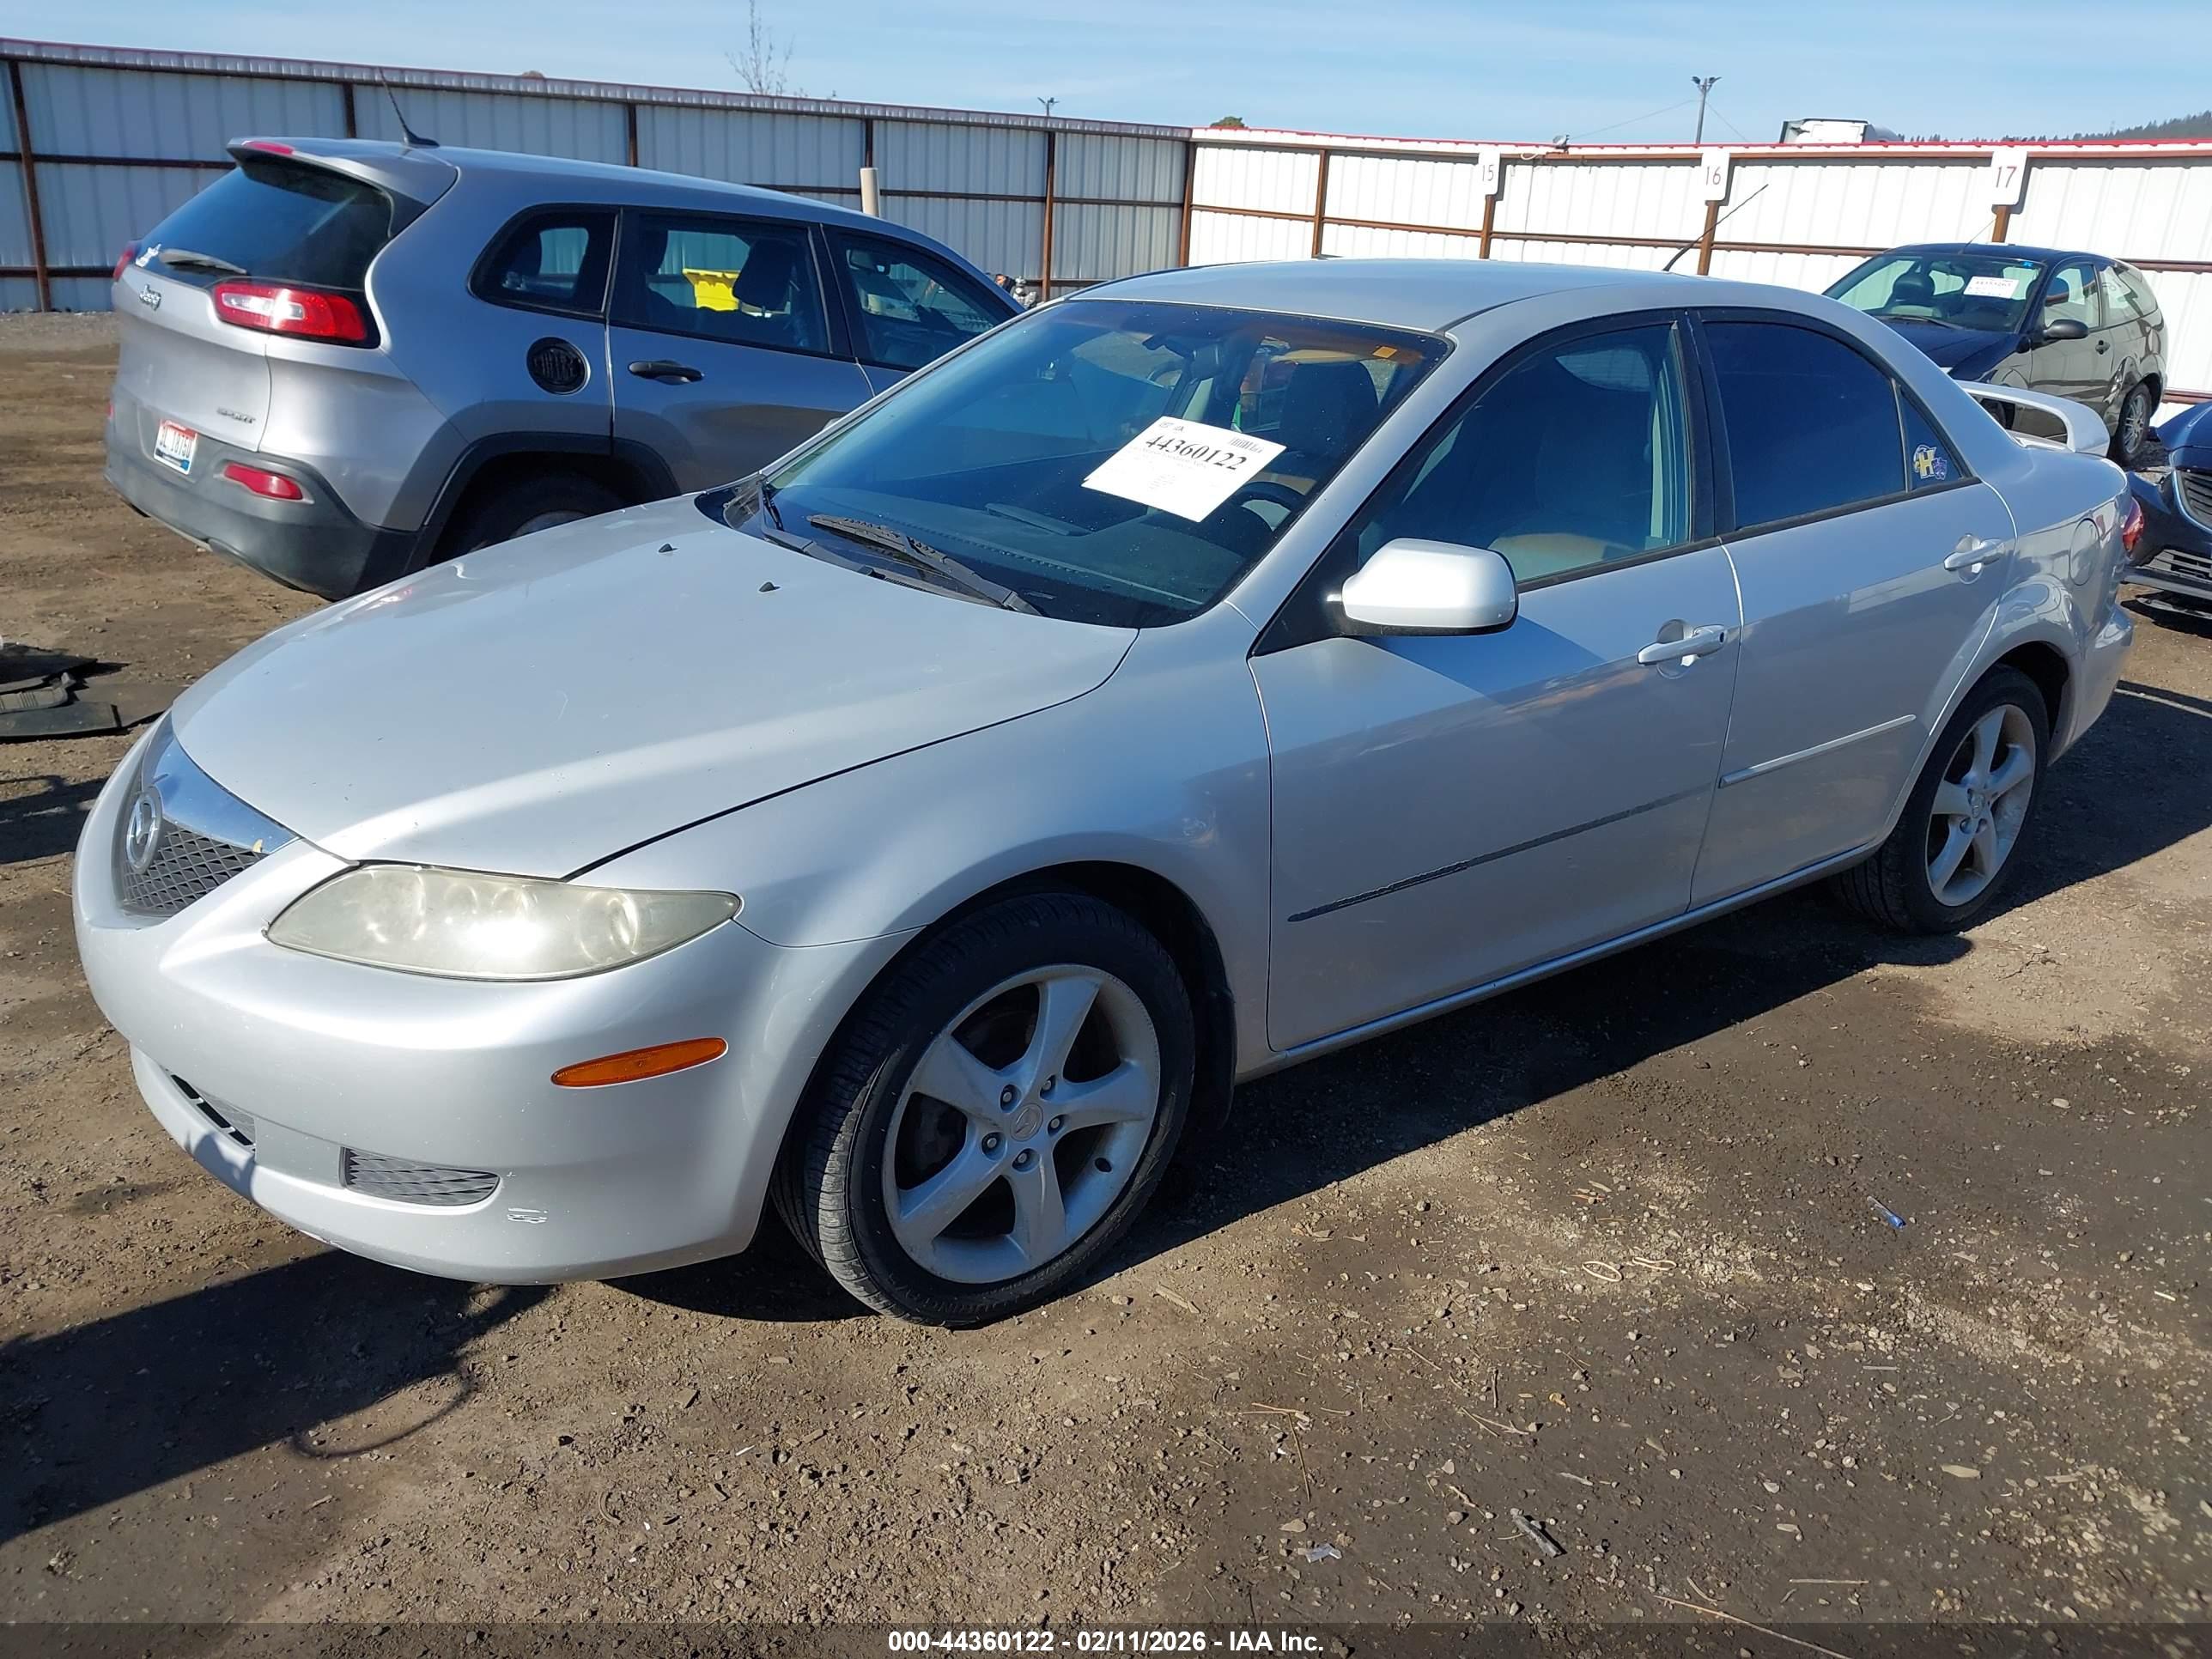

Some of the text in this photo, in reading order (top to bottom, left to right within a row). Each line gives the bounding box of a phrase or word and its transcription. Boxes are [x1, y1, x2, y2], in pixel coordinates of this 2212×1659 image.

[1482, 164, 1494, 181] 15
[1705, 166, 1721, 185] 16
[1996, 166, 2017, 188] 17
[1146, 434, 1248, 471] 44360122
